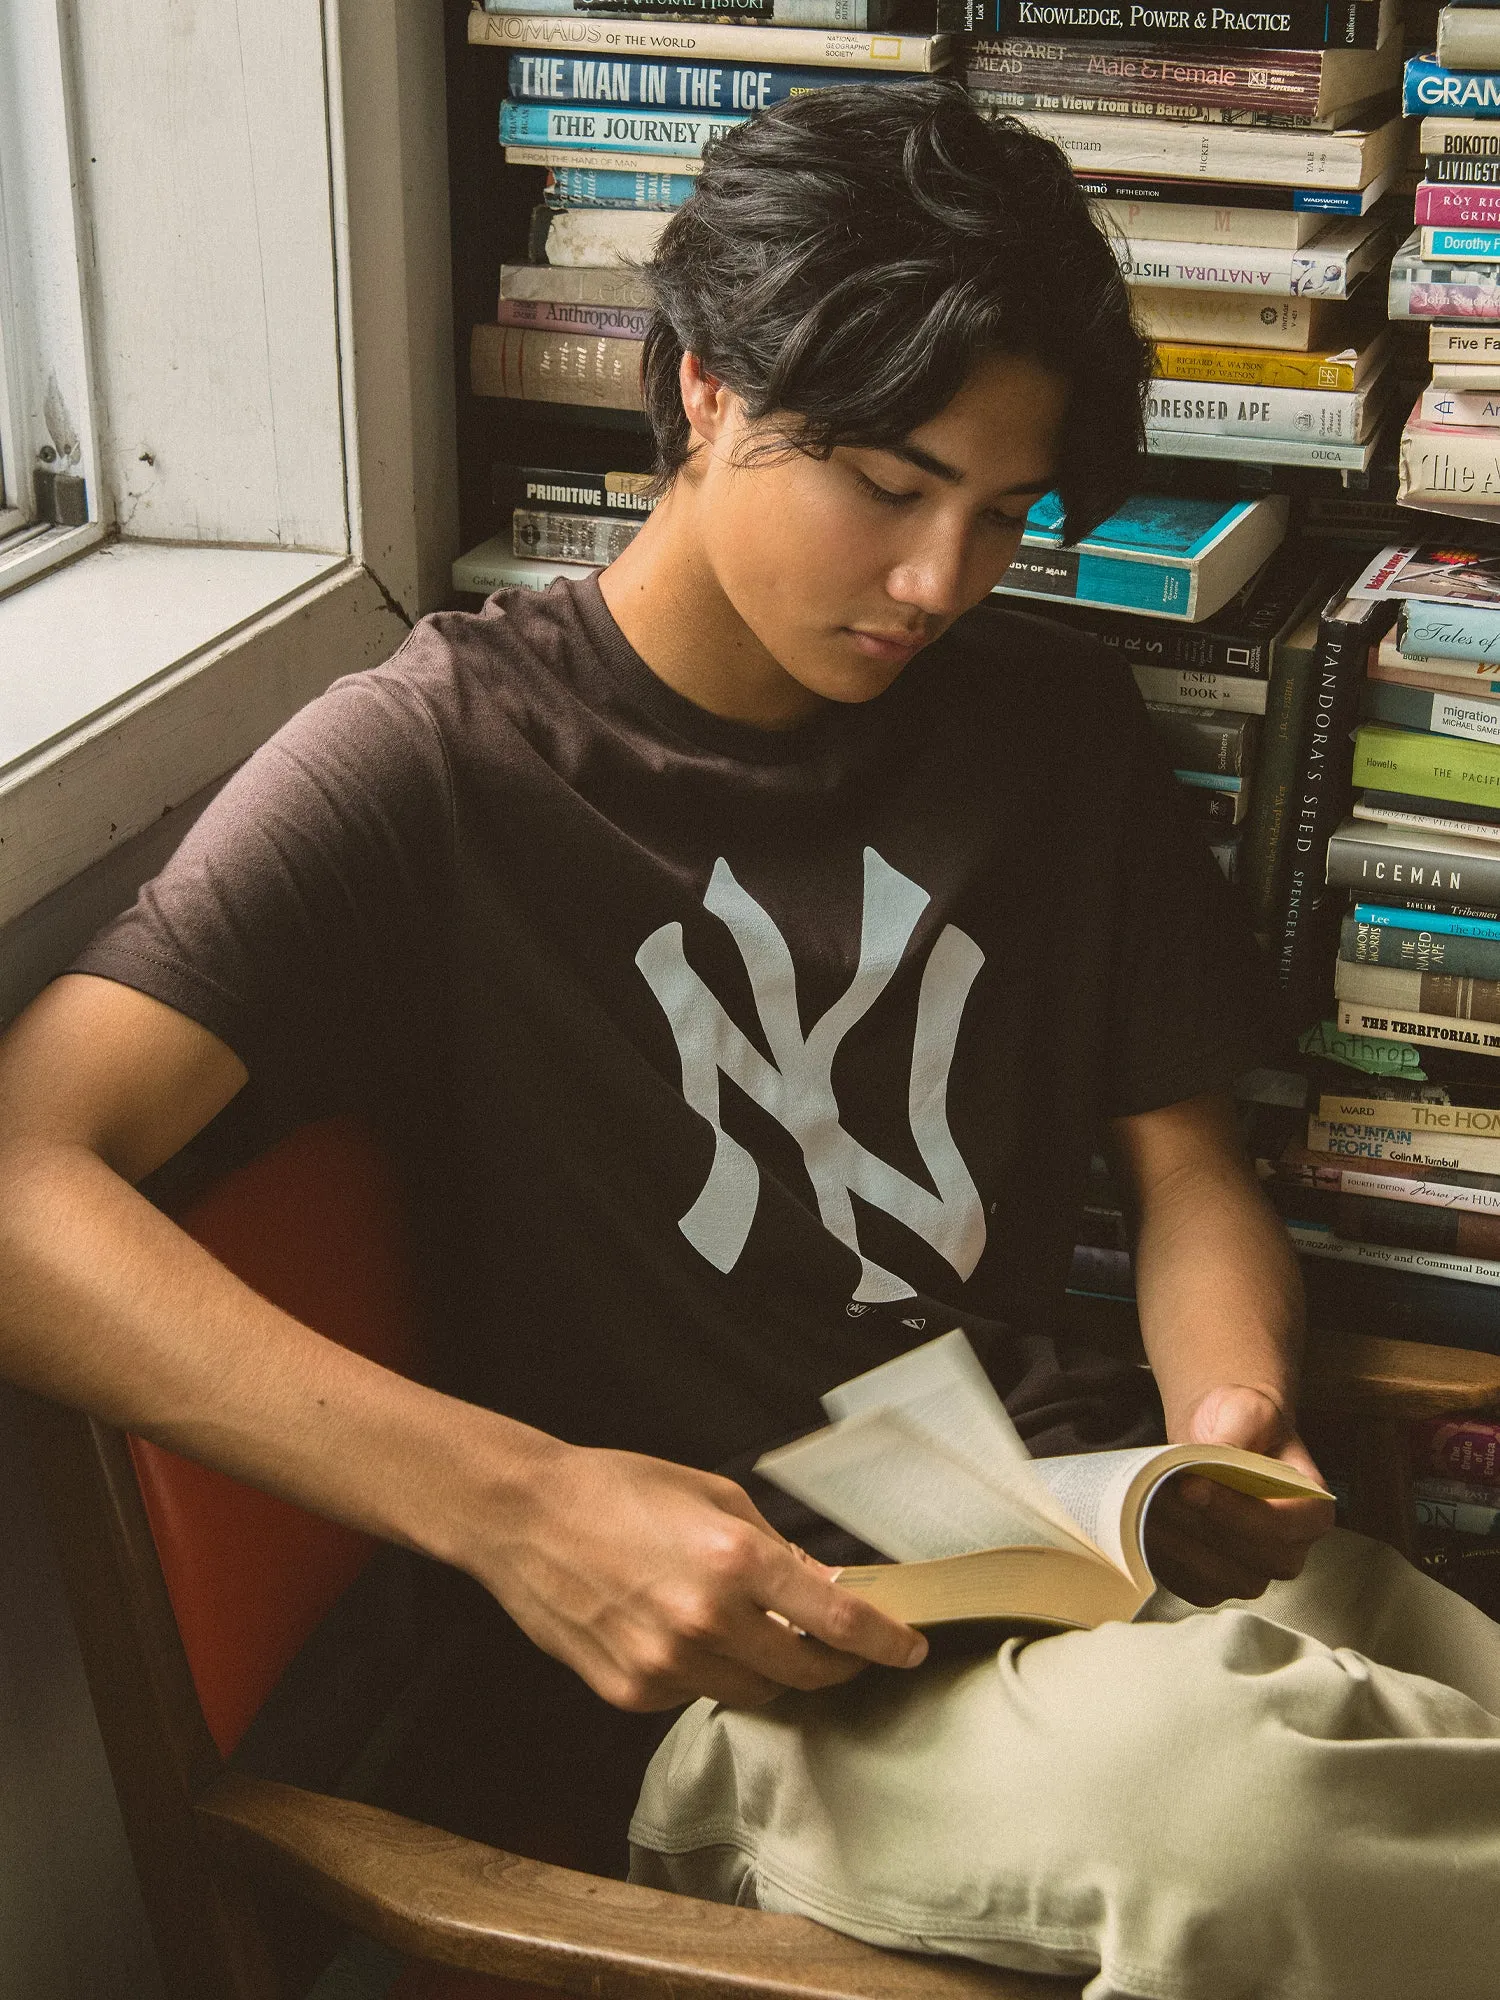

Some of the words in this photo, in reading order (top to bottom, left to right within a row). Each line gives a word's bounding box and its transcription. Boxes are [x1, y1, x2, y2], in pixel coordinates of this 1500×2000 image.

[975, 4, 984, 20] Lock
[1130, 5, 1189, 28] POWER
[1193, 12, 1207, 29] &
[1211, 7, 1291, 32] PRACTICE
[485, 17, 602, 43] NOMADS
[606, 33, 621, 44] OF
[625, 35, 646, 46] THE
[650, 36, 696, 49] WORLD
[1345, 4, 1356, 43] California
[825, 43, 870, 51] GEOGRAPHIC
[976, 40, 1067, 60] MARGARET
[974, 57, 1023, 74] MEAD
[1087, 54, 1136, 77] Male
[1141, 59, 1158, 78] &
[1161, 62, 1237, 87] Female
[519, 57, 565, 98] THE
[573, 60, 630, 102] MAN
[639, 65, 667, 103] IN
[676, 67, 722, 108] THE
[731, 72, 772, 111] ICE
[978, 90, 1025, 106] Peattie
[1034, 93, 1060, 109] The
[1062, 94, 1095, 111] View
[1097, 98, 1129, 114] from
[1131, 100, 1154, 115] the
[1155, 103, 1199, 118] Barrio
[553, 114, 595, 138] THE
[603, 117, 702, 144] JOURNEY
[1199, 136, 1209, 172] HICKEY
[1444, 134, 1500, 155] BOKOTO
[522, 154, 548, 163] FROM
[552, 155, 569, 165] THE
[571, 156, 598, 167] HAND
[601, 158, 613, 167] OF
[615, 159, 638, 168] MAN
[1305, 151, 1315, 174] YALE
[1437, 160, 1500, 182] LIVINGST
[1115, 188, 1134, 196] FIFTH
[1135, 189, 1160, 197] EDITION
[1302, 196, 1349, 205] WADSWORTH
[1443, 195, 1472, 206] ROY
[1460, 211, 1500, 222] GRIN
[1444, 235, 1491, 254] Dorothy
[1175, 264, 1254, 284] NATURAL
[545, 302, 646, 336] Anthropology
[1281, 303, 1290, 331] VINTAGE
[1448, 337, 1479, 350] Five
[1175, 366, 1202, 375] PATTY
[1205, 368, 1217, 376] JO
[1218, 370, 1256, 379] WATSON
[1176, 356, 1213, 368] RICHARD
[1227, 361, 1264, 371] WATSON
[1150, 398, 1229, 421] DRESSED
[1237, 401, 1271, 422] APE
[1421, 454, 1475, 492] The
[526, 483, 602, 506] PRIMITIVE
[1030, 564, 1045, 573] OF
[1046, 567, 1068, 577] MAN
[1414, 622, 1473, 645] Tales
[1402, 653, 1429, 663] BODLEY
[1182, 671, 1217, 685] USED
[1179, 686, 1218, 700] BOOK
[1308, 641, 1342, 781] PANDORA'S
[1443, 705, 1498, 725] migration
[1442, 717, 1475, 731] MICHAEL
[1218, 733, 1229, 770] Scribners
[1366, 757, 1398, 771] Howells
[1433, 767, 1452, 779] THE
[1296, 794, 1319, 853] SEED
[1432, 818, 1474, 832] VILLAGE
[1476, 826, 1488, 834] IN
[1362, 859, 1462, 890] ICEMAN
[1284, 870, 1305, 938] SPENCER
[1406, 901, 1436, 911] SAHLINS
[1450, 904, 1498, 919] Tribesmen
[1370, 914, 1390, 925] Lee
[1450, 924, 1470, 935] The
[1368, 927, 1381, 962] MORRIS
[1400, 940, 1416, 960] THE
[1416, 931, 1432, 972] NAKED
[1431, 943, 1445, 964] APE
[1361, 1016, 1388, 1032] THE
[1390, 1020, 1480, 1046] TERRITORIAL
[1340, 1105, 1375, 1117] WARD
[1411, 1107, 1451, 1126] The
[1328, 1122, 1413, 1146] MOUNTAIN
[1328, 1138, 1383, 1158] PEOPLE
[1389, 1151, 1412, 1163] Colin
[1413, 1153, 1424, 1164] M.
[1424, 1155, 1460, 1169] Turnbull
[1347, 1179, 1375, 1189] FOURTH
[1376, 1183, 1406, 1193] EDITION
[1358, 1247, 1392, 1263] Purity
[1394, 1254, 1414, 1264] and
[1416, 1256, 1473, 1274] Communal
